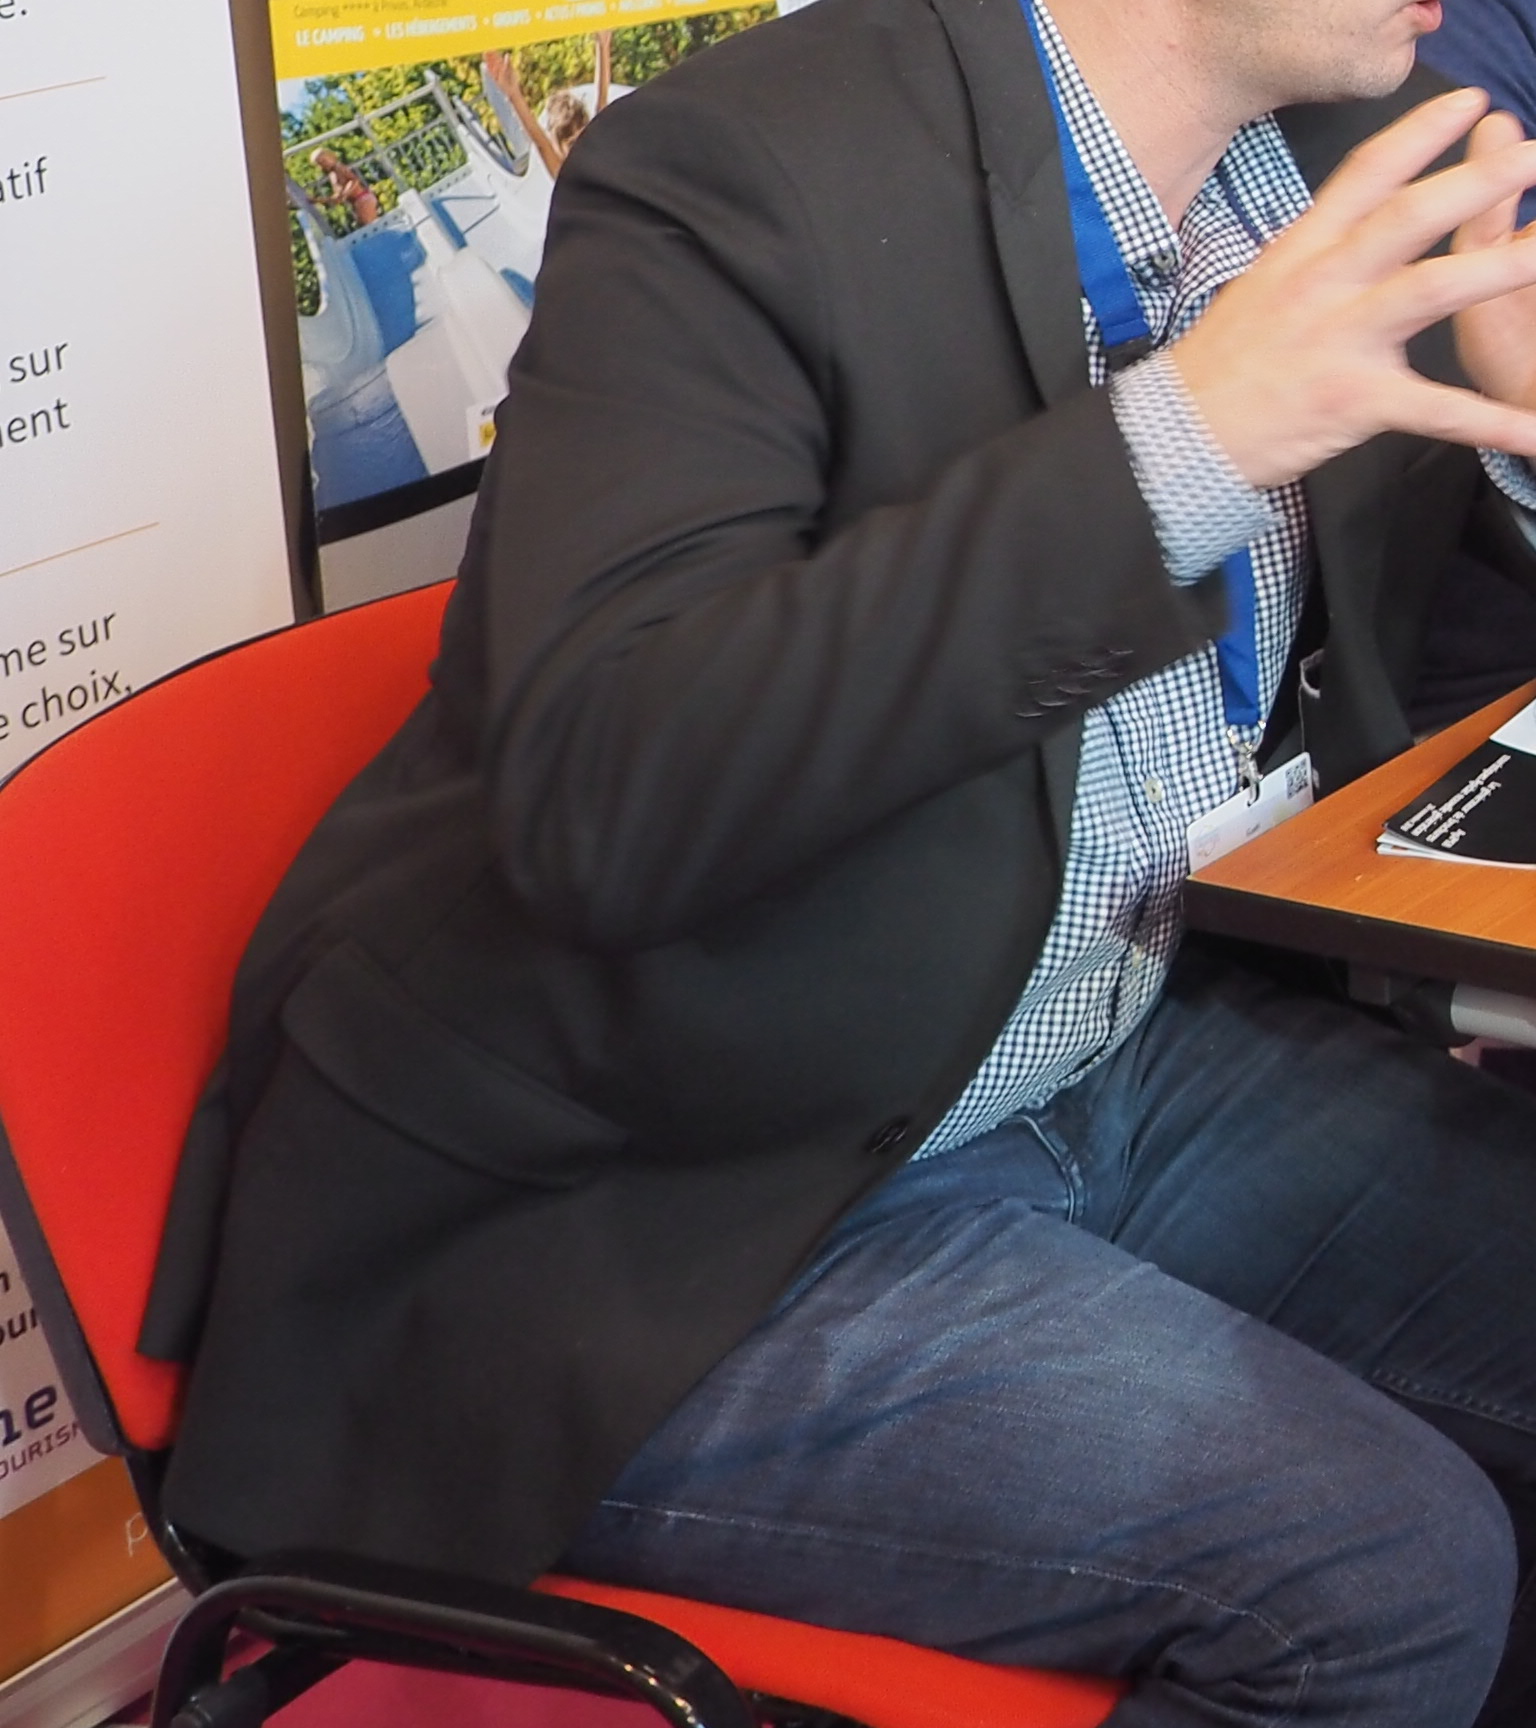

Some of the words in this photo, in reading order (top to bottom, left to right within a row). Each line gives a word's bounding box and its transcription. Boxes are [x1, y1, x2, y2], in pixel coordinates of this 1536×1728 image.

[9, 342, 68, 382] sur
[0, 398, 71, 447] ent
[59, 613, 116, 656] sur
